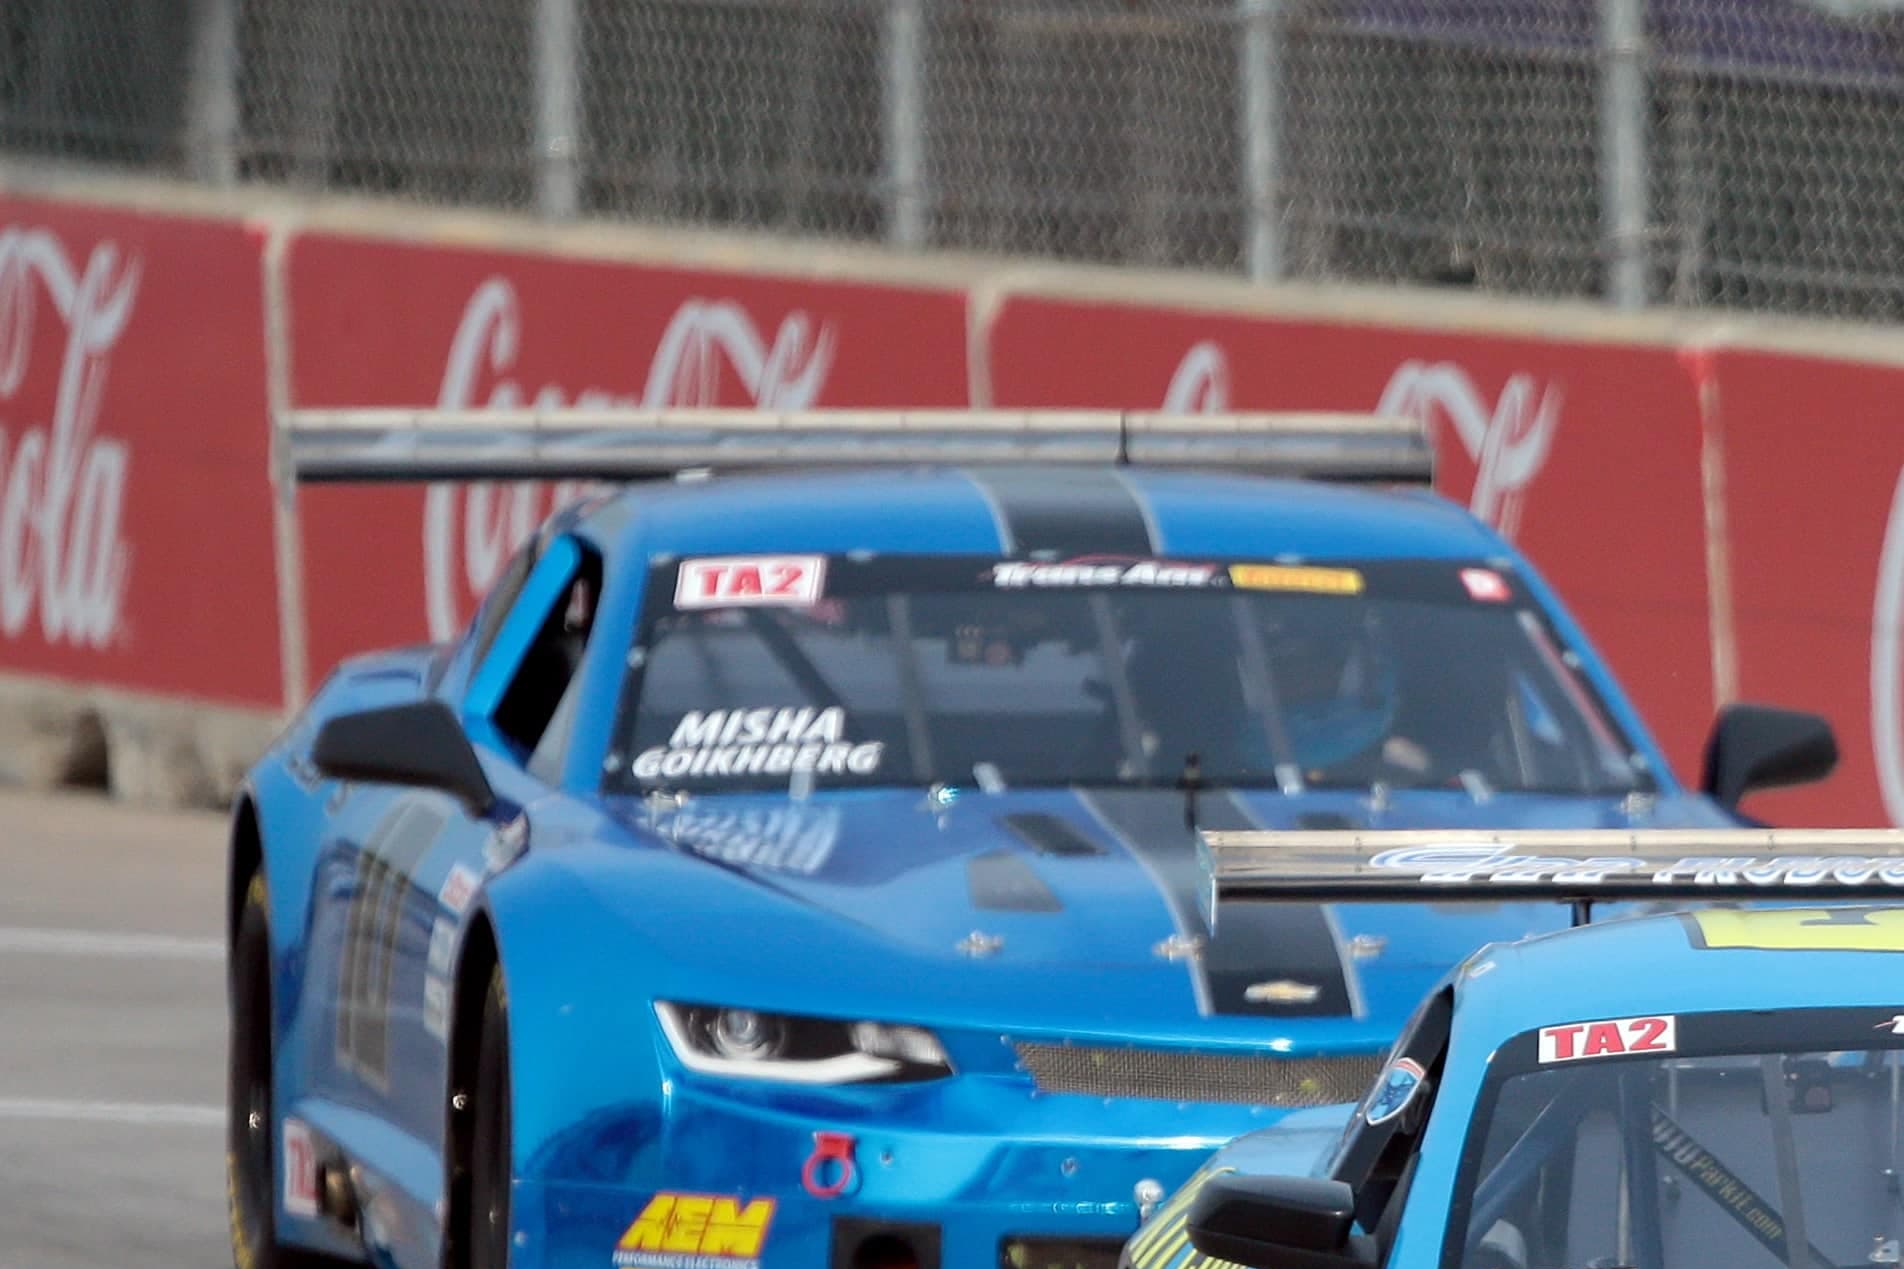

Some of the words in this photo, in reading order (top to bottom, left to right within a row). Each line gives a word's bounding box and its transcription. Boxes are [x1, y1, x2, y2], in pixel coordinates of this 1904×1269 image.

[696, 562, 803, 598] TA2
[992, 559, 1121, 590] Trans
[1121, 560, 1211, 588] Am
[669, 705, 845, 751] MISHA
[632, 741, 885, 780] GOIKHBERG
[1544, 1018, 1670, 1059] TA2
[616, 1190, 779, 1259] AEM
